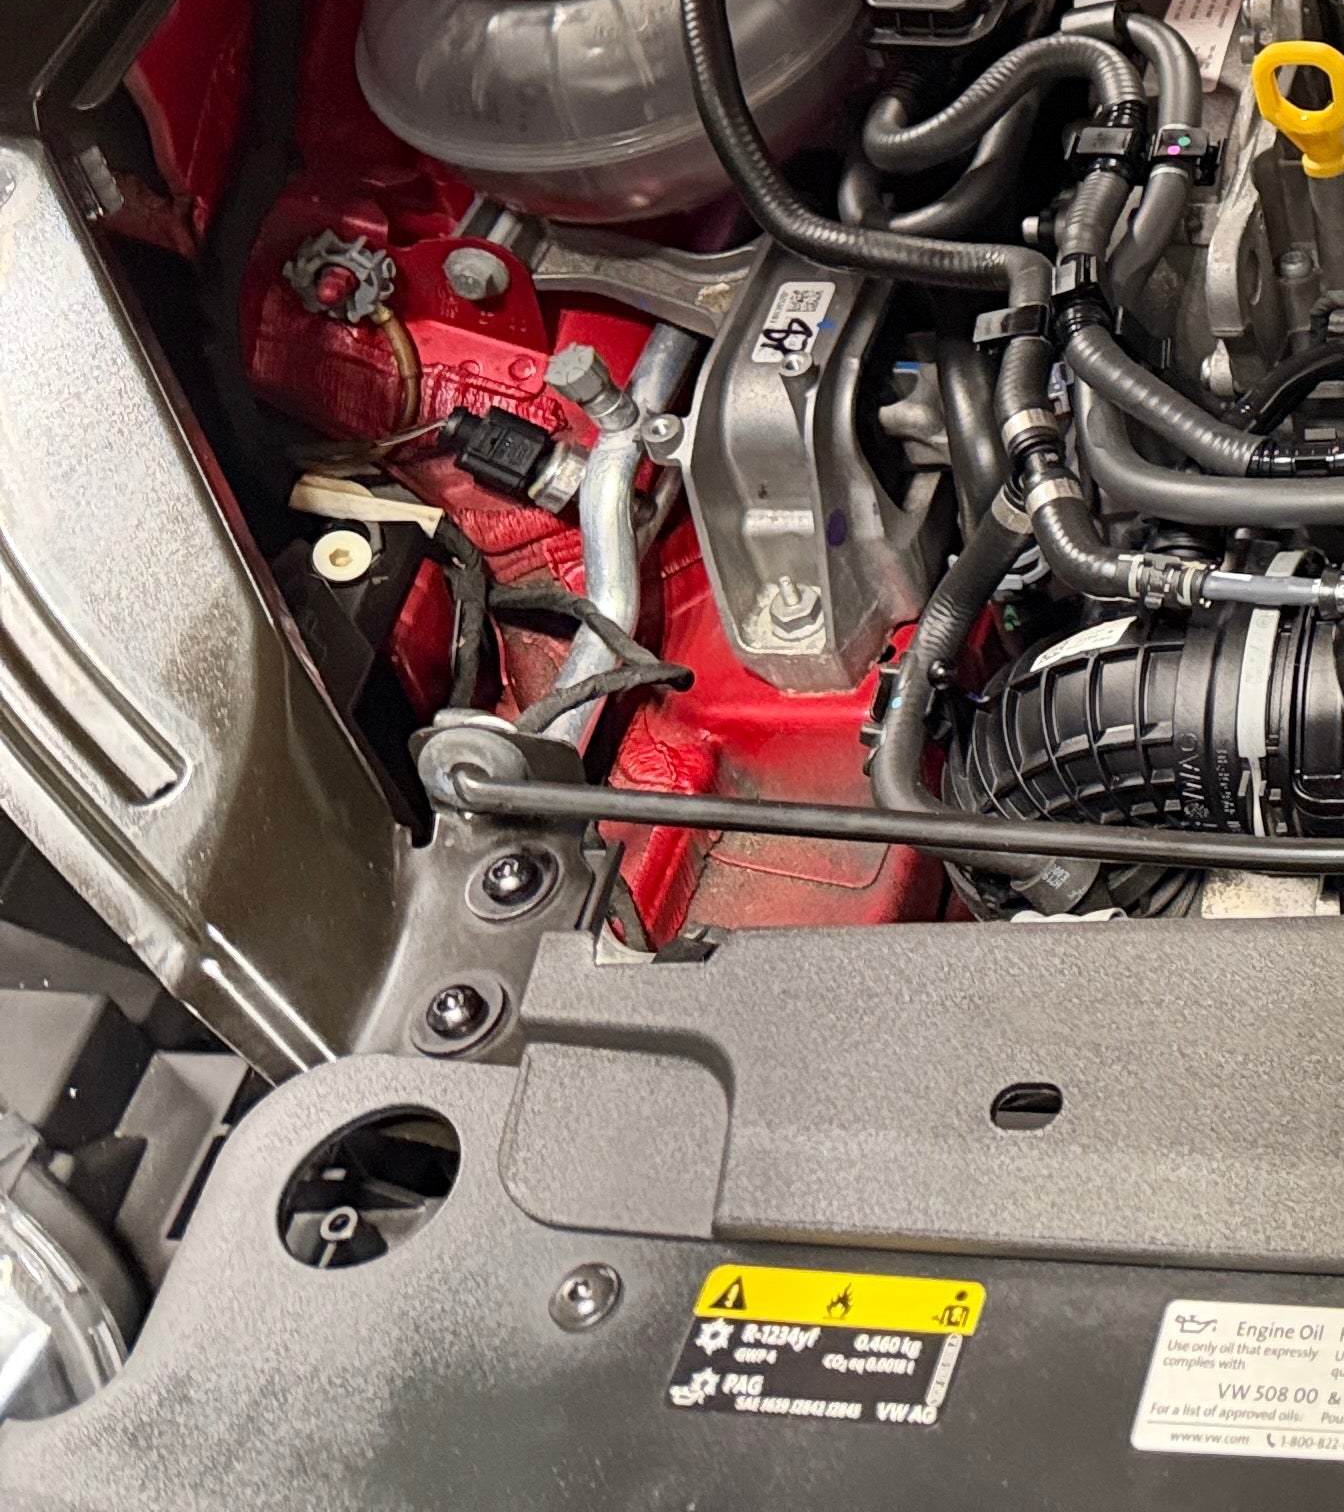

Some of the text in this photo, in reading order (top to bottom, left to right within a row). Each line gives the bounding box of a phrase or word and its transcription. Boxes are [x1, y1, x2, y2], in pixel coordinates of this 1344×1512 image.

[740, 1324, 822, 1352] R-1234yf
[1236, 1321, 1325, 1342] Engine Oil
[1167, 1339, 1319, 1362] Use only oil that expressly
[1162, 1355, 1246, 1371] complies with
[721, 1373, 765, 1396] PAG
[1218, 1382, 1251, 1400] VW
[1253, 1385, 1290, 1403] 508
[1293, 1387, 1319, 1404] 00
[1327, 1391, 1342, 1406] &
[875, 1401, 938, 1425] VW AG
[1150, 1402, 1171, 1415] For
[1171, 1406, 1180, 1416] a
[1182, 1403, 1200, 1417] list
[1203, 1404, 1218, 1418] of
[1218, 1406, 1277, 1422] approved
[1170, 1431, 1250, 1445] www.vw.com
